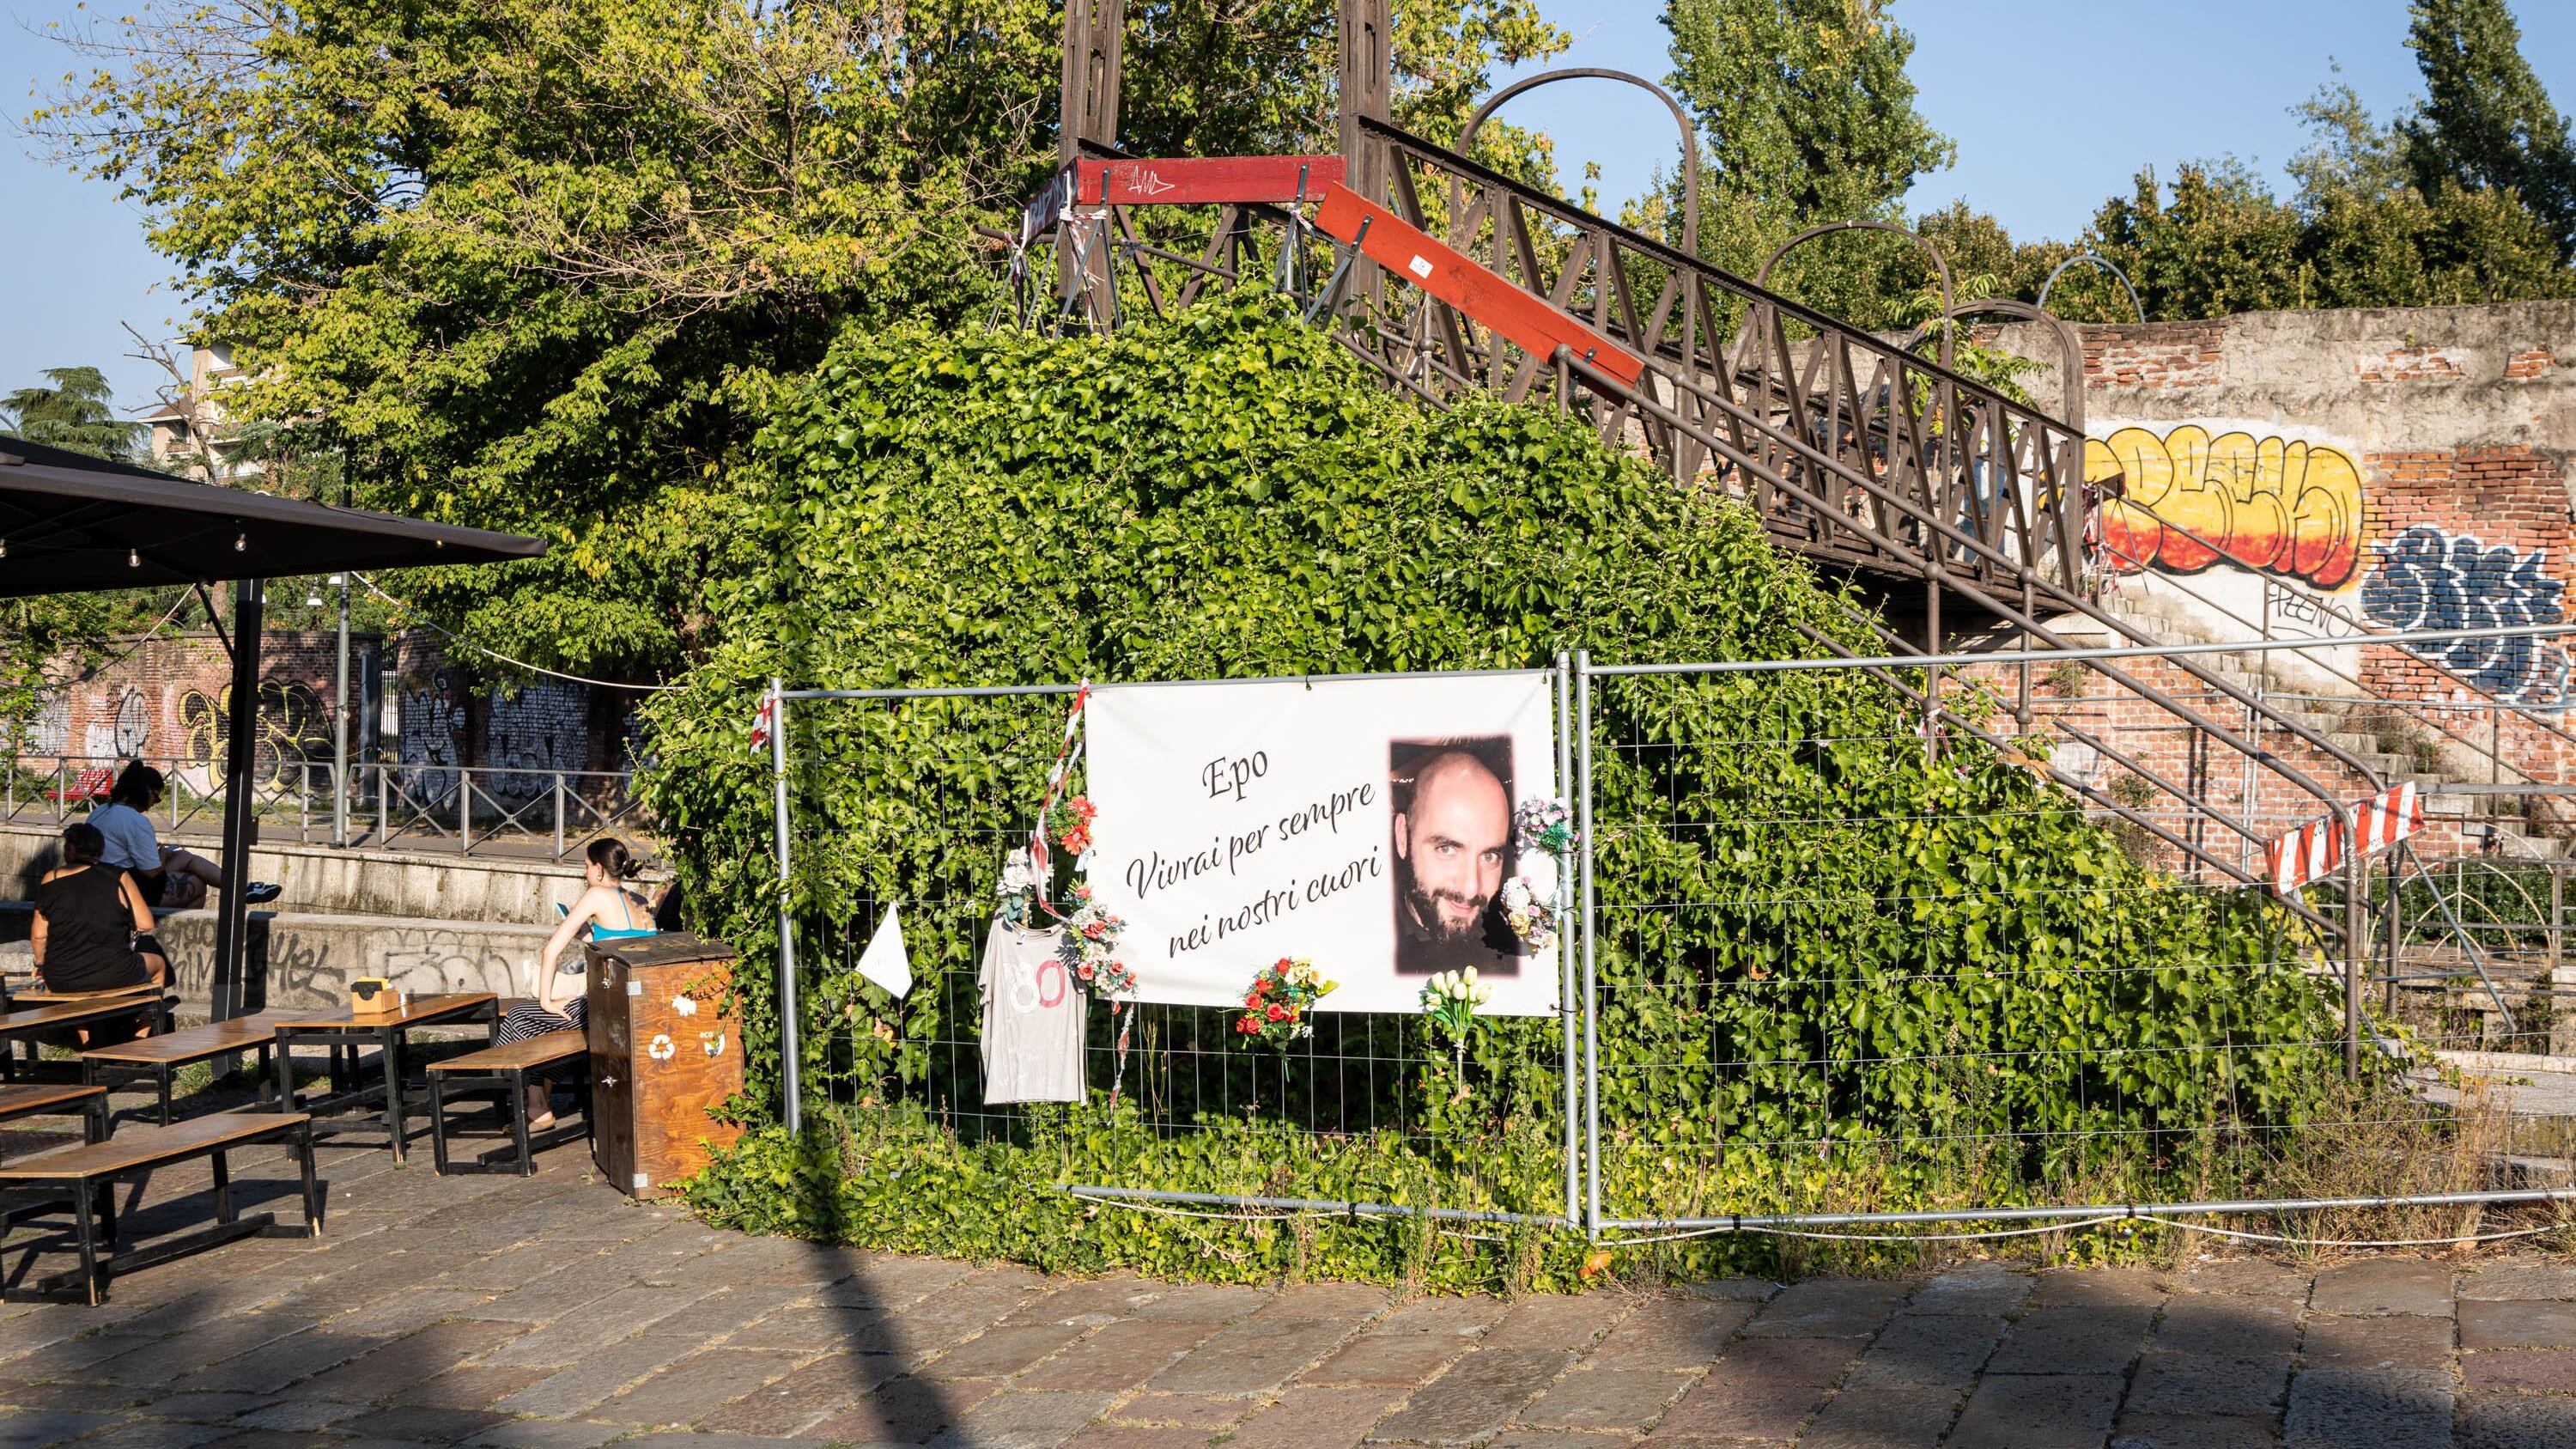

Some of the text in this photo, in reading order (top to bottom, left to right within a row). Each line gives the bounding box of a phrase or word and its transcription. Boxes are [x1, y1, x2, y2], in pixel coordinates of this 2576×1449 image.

[1202, 751, 1268, 802] Epo
[1126, 782, 1376, 900] Vivrai per sempre
[1170, 845, 1382, 959] nei nostri cuori
